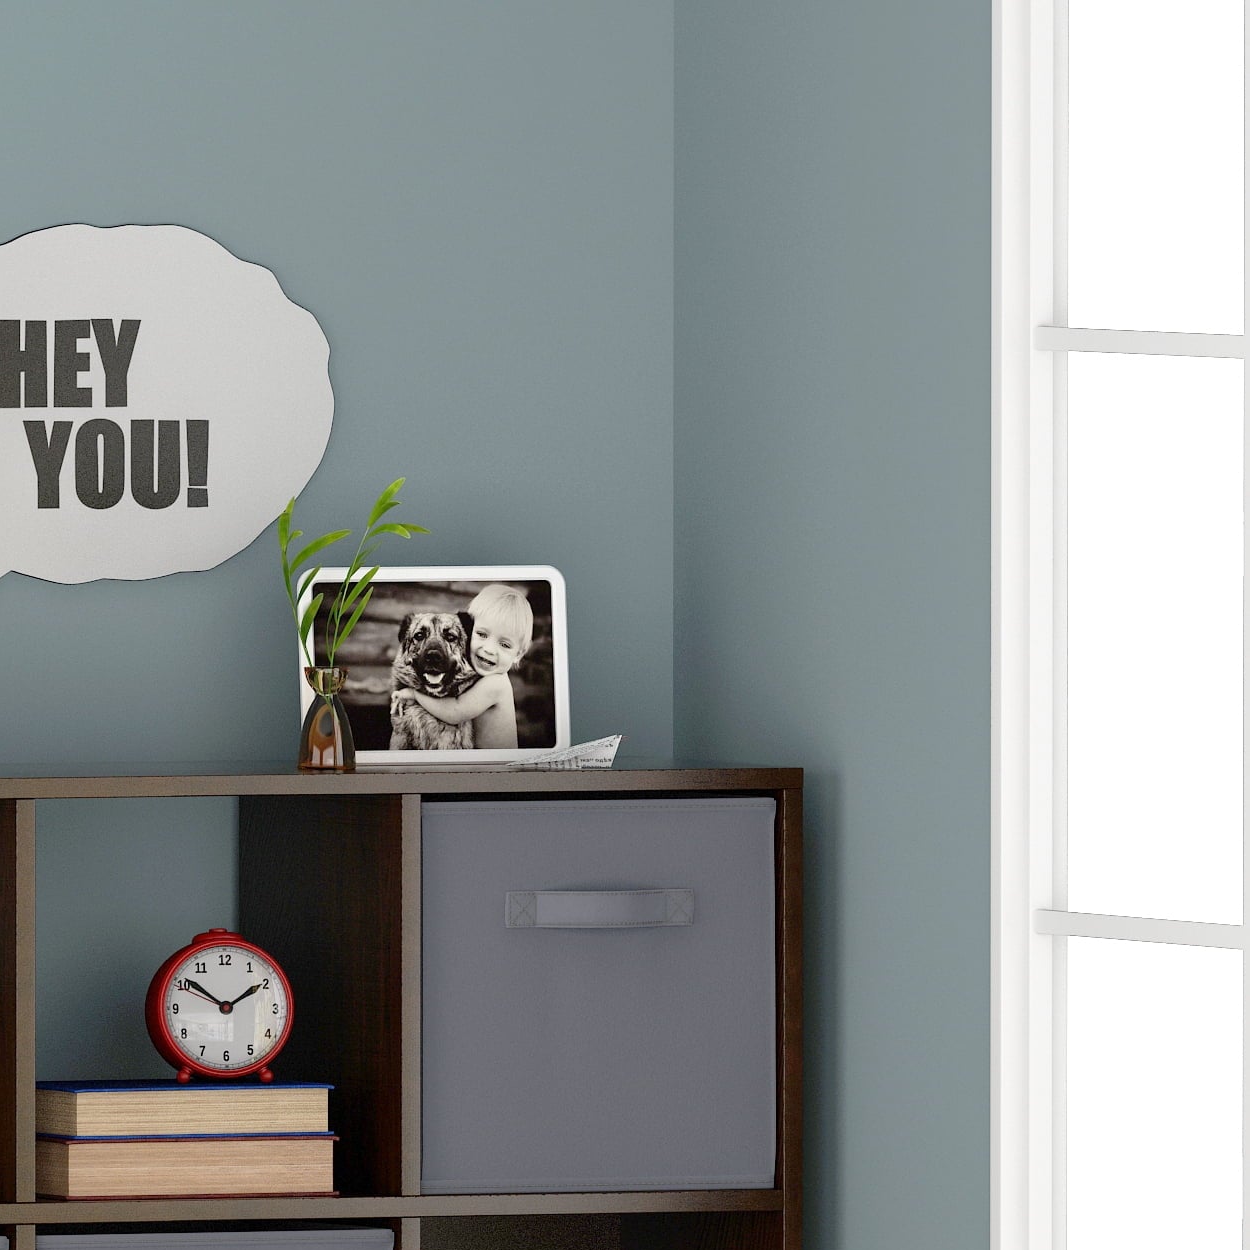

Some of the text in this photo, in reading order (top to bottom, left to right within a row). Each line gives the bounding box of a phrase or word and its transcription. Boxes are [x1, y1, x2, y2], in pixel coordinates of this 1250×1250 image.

[22, 418, 210, 510] YOU!
[218, 954, 232, 966] 12
[195, 962, 208, 974] 11
[246, 962, 254, 973] 1
[177, 980, 190, 991] 10
[262, 979, 270, 990] 2
[172, 1003, 179, 1014] 9
[272, 1003, 279, 1014] 3
[180, 1028, 188, 1039] 8
[264, 1028, 272, 1039] 4
[199, 1046, 206, 1057] 7
[247, 1044, 254, 1055] 5
[223, 1050, 230, 1062] 6
